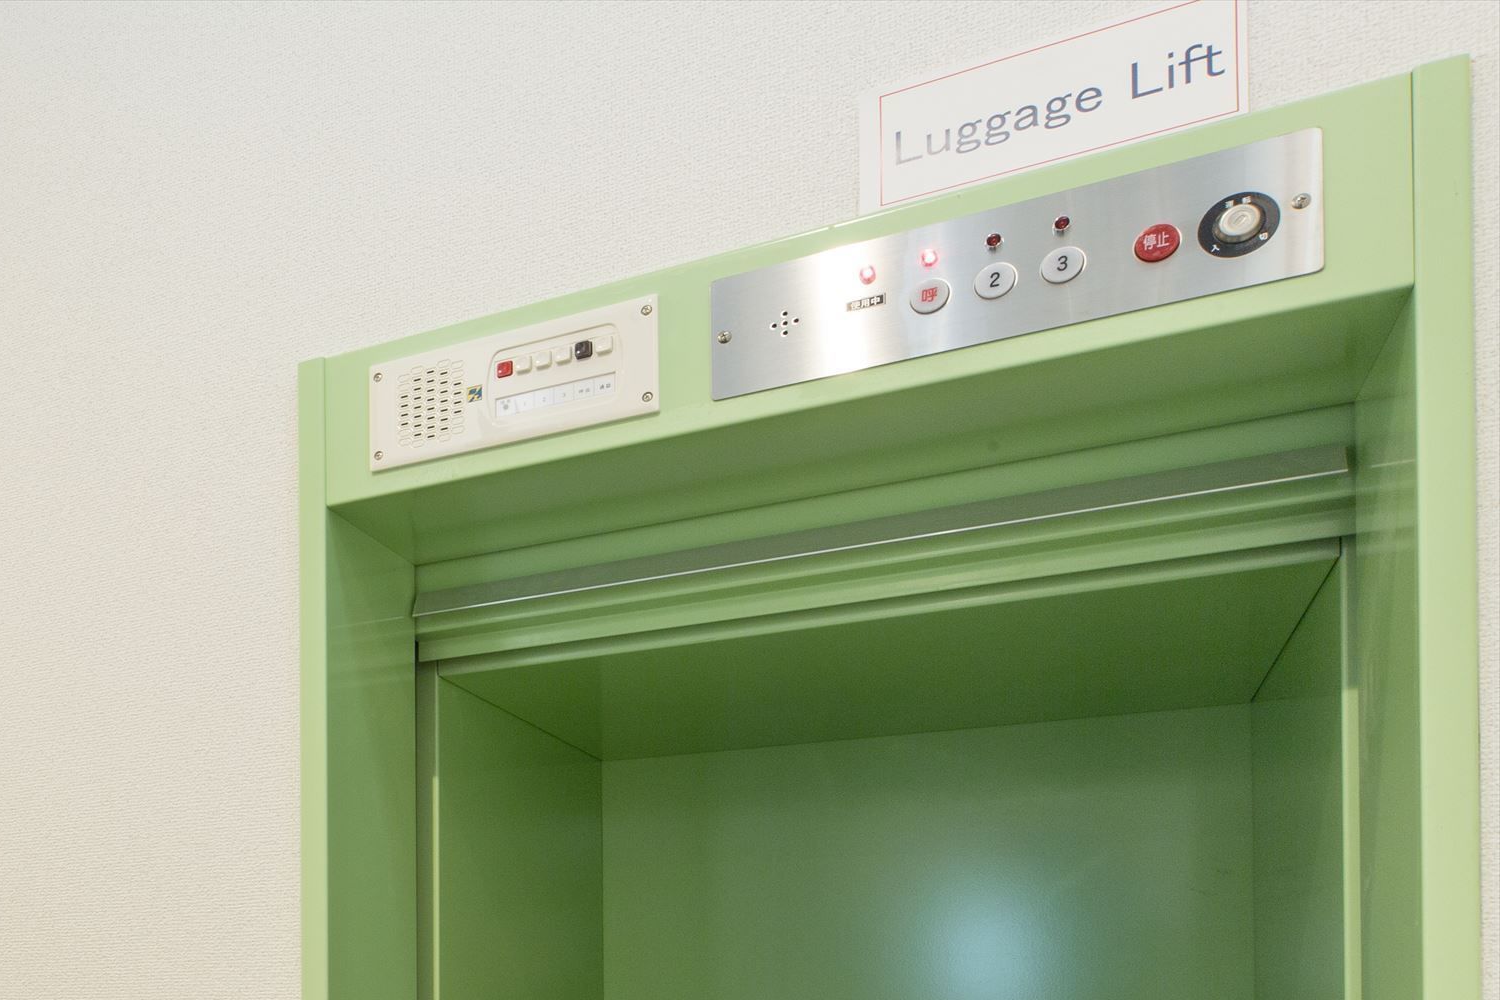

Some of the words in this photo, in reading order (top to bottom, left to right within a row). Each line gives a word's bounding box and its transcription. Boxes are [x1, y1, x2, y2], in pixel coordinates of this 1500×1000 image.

[894, 87, 1103, 166] Luggage
[1131, 43, 1227, 100] Lift
[1143, 231, 1171, 251] 停止
[1057, 255, 1068, 272] 3
[990, 272, 1001, 288] 2
[850, 294, 881, 310] 使用中
[921, 286, 938, 303] 呼
